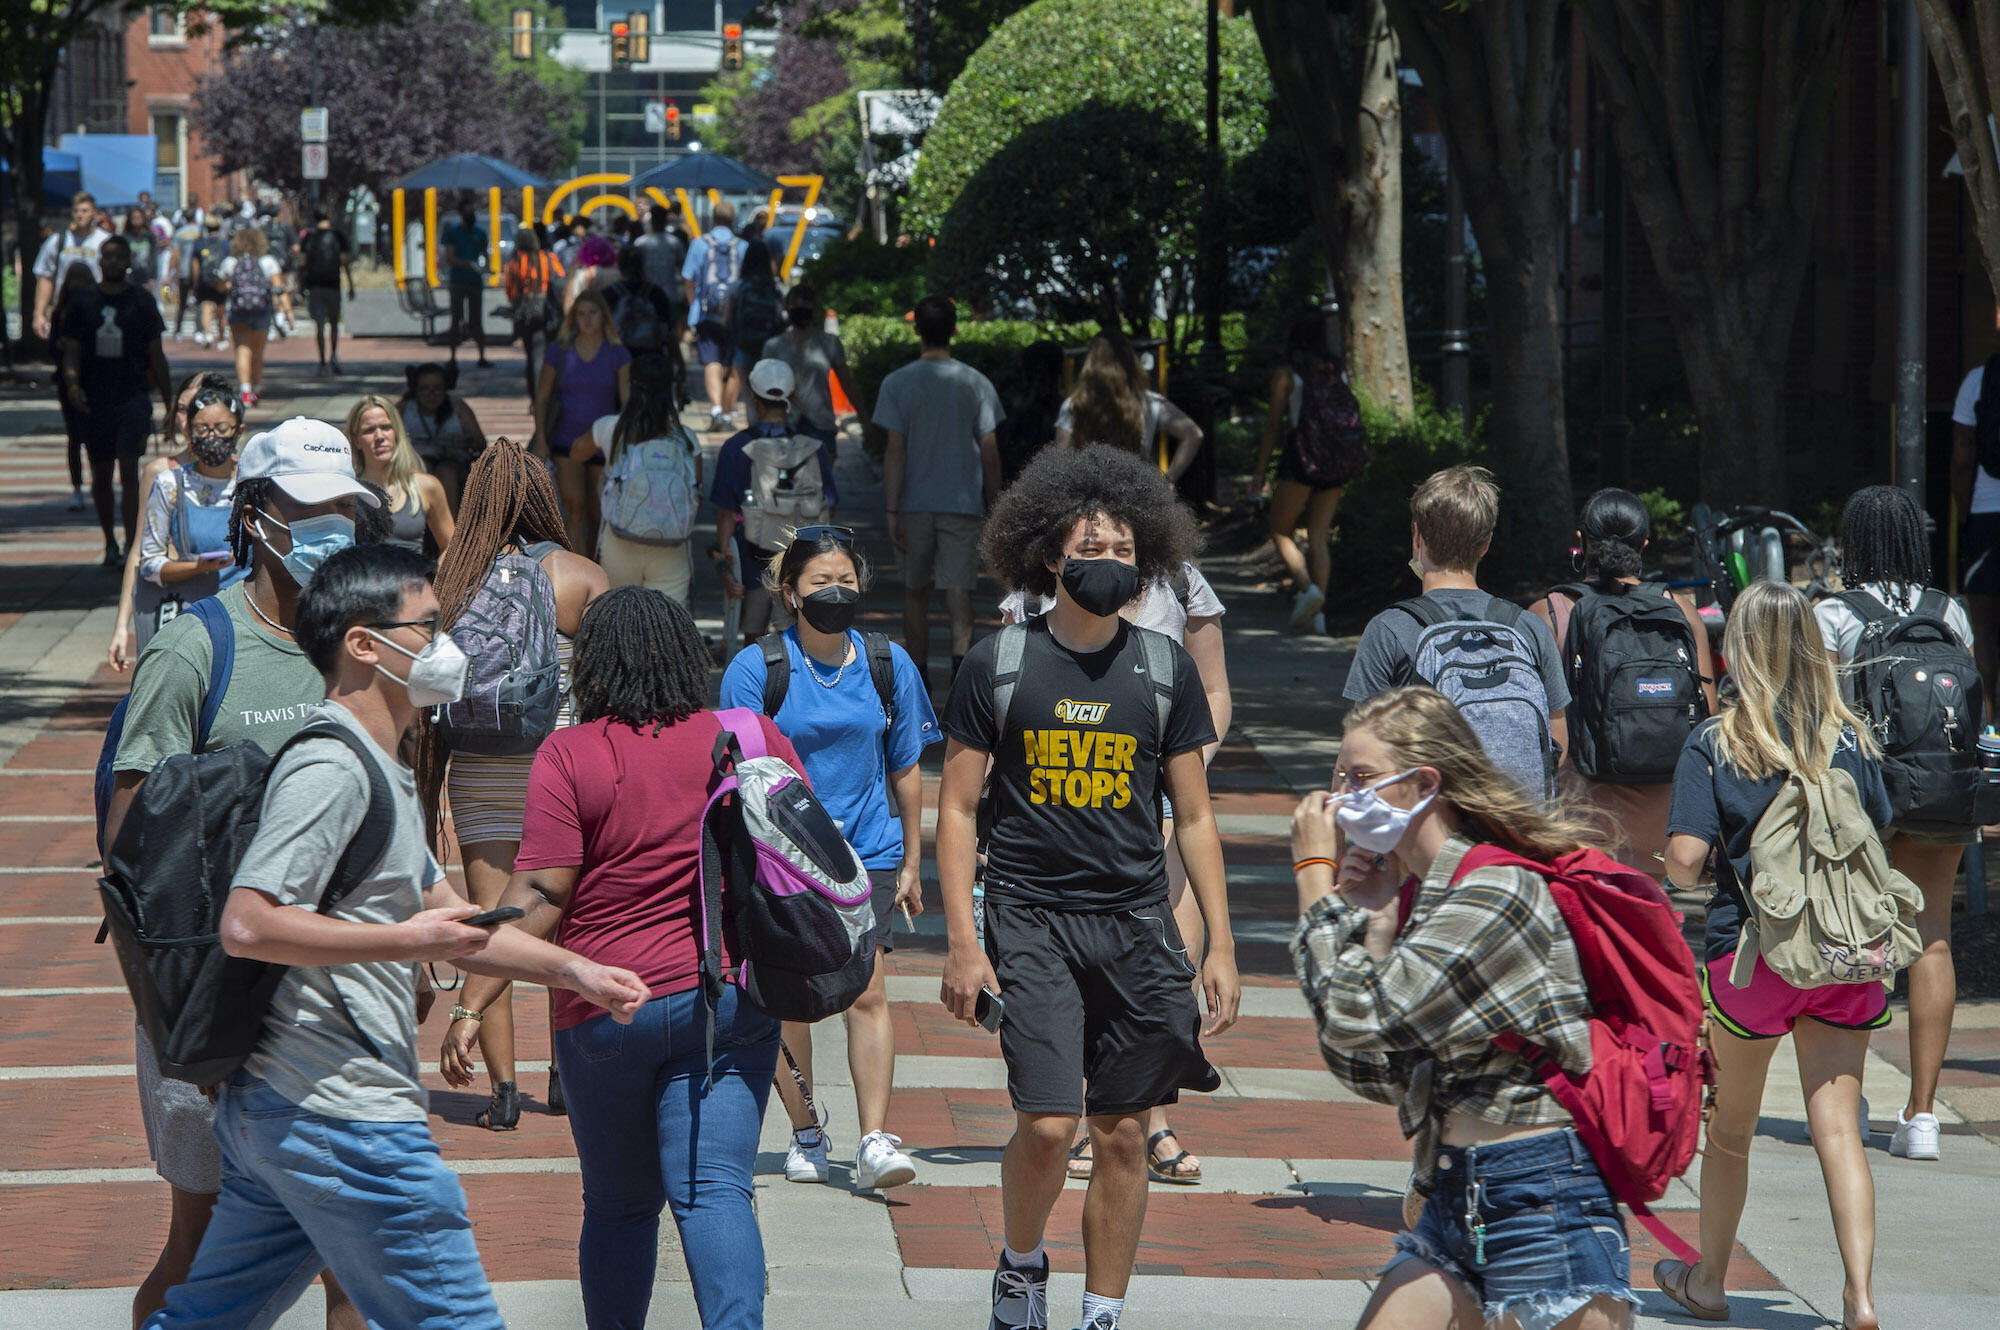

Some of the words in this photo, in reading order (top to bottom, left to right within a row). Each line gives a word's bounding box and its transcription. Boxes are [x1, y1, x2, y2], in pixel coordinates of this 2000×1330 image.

[240, 706, 295, 726] TRAVIS
[1055, 699, 1110, 724] VCU
[1023, 730, 1137, 771] NEVER
[1029, 767, 1132, 809] STOPS
